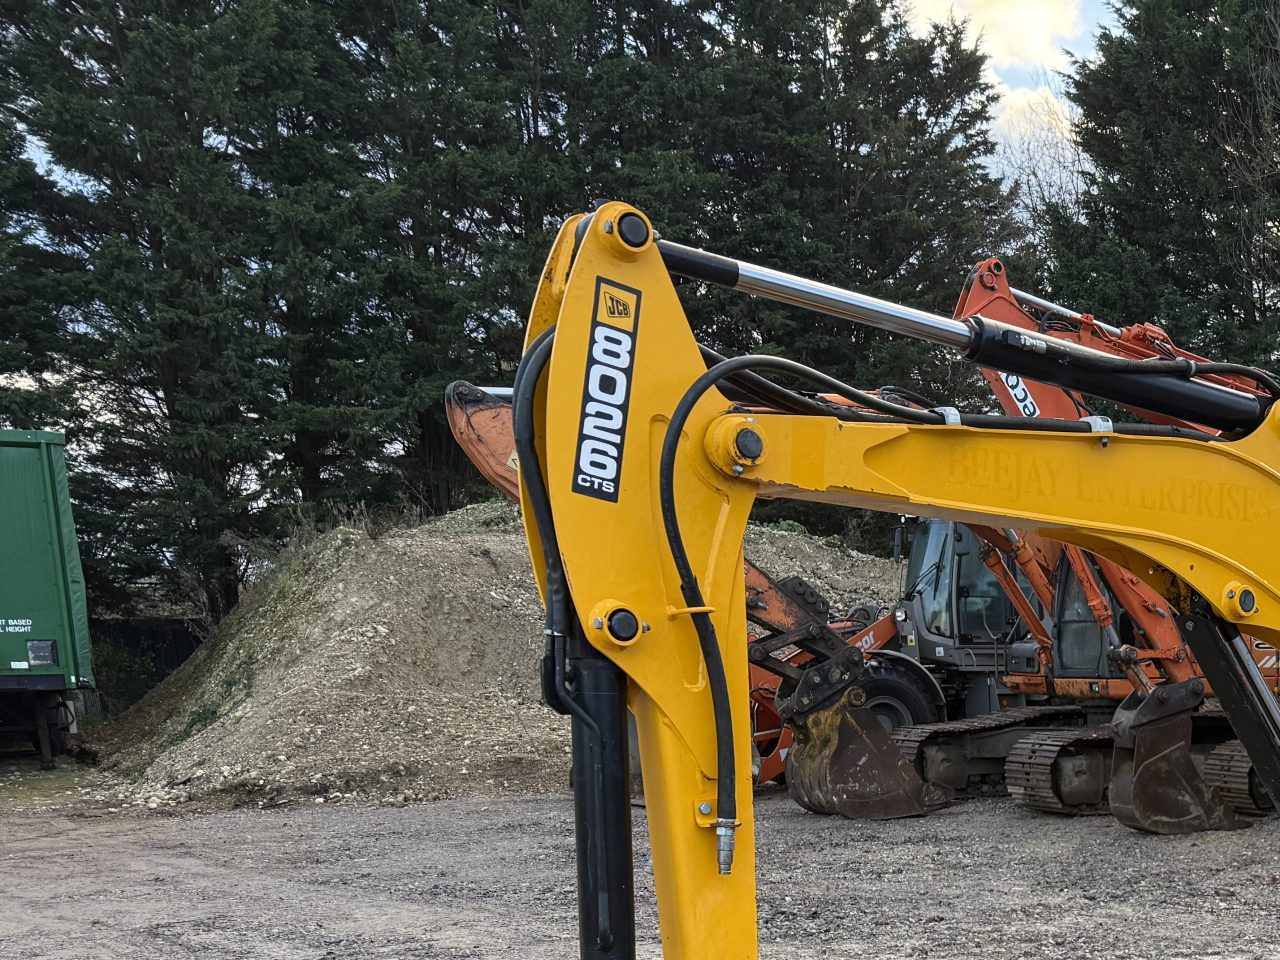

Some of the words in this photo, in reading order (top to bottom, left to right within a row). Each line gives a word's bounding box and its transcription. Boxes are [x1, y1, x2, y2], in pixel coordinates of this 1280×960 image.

[607, 294, 629, 317] JCB
[578, 325, 632, 481] 8026
[577, 474, 615, 494] CTS
